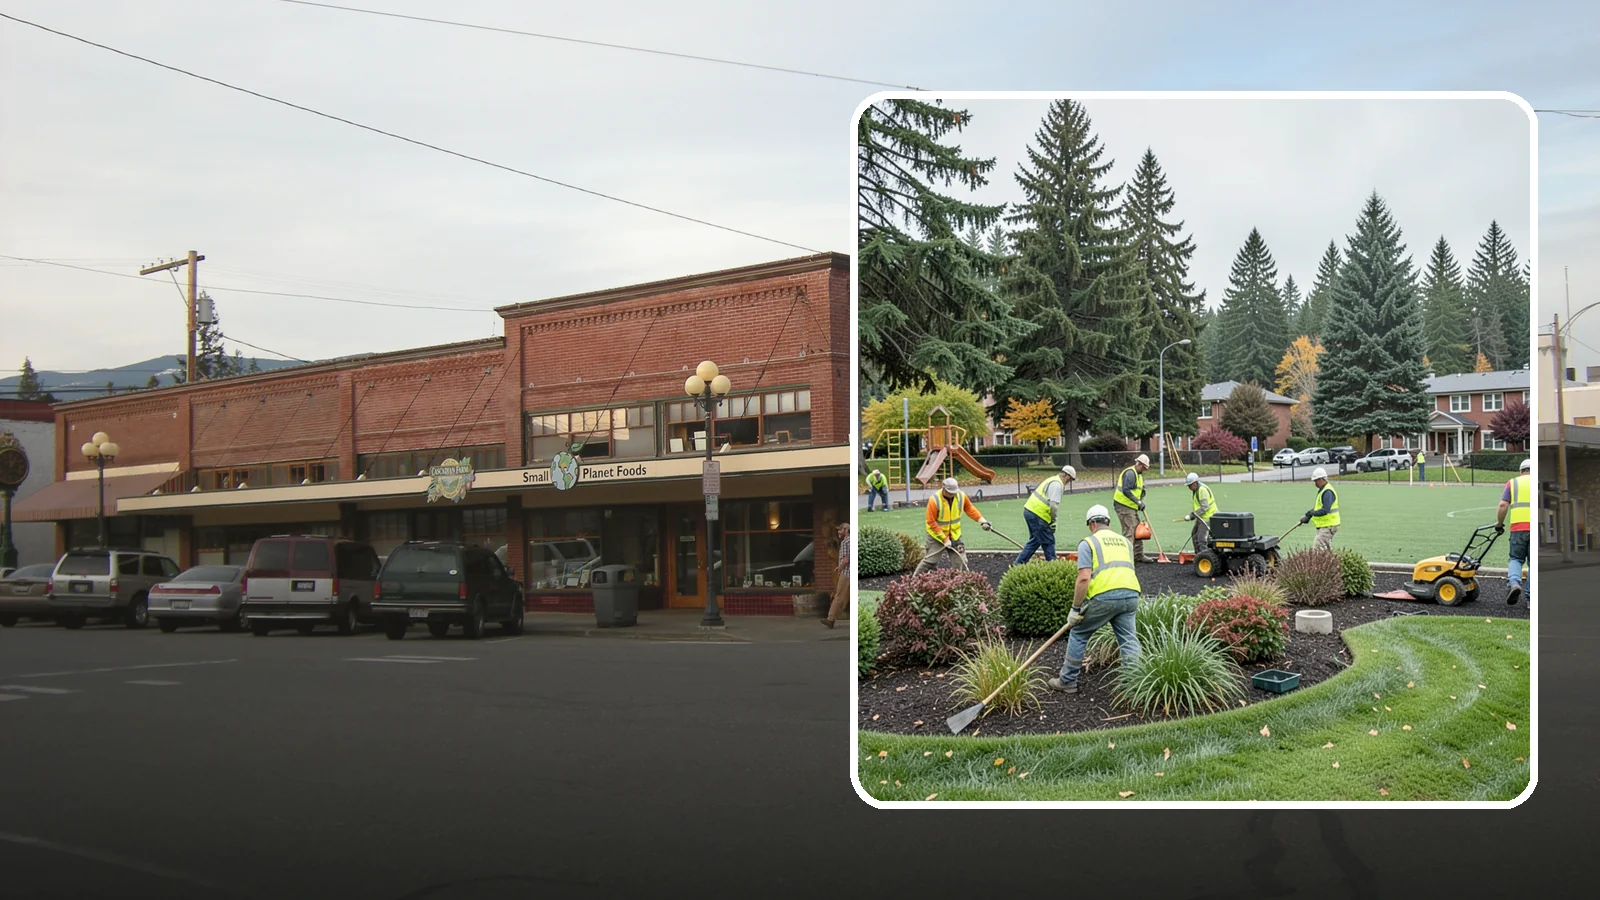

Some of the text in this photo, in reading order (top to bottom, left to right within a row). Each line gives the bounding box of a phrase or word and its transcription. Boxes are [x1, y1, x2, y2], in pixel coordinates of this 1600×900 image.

[523, 464, 647, 482] Small Planet Foods
